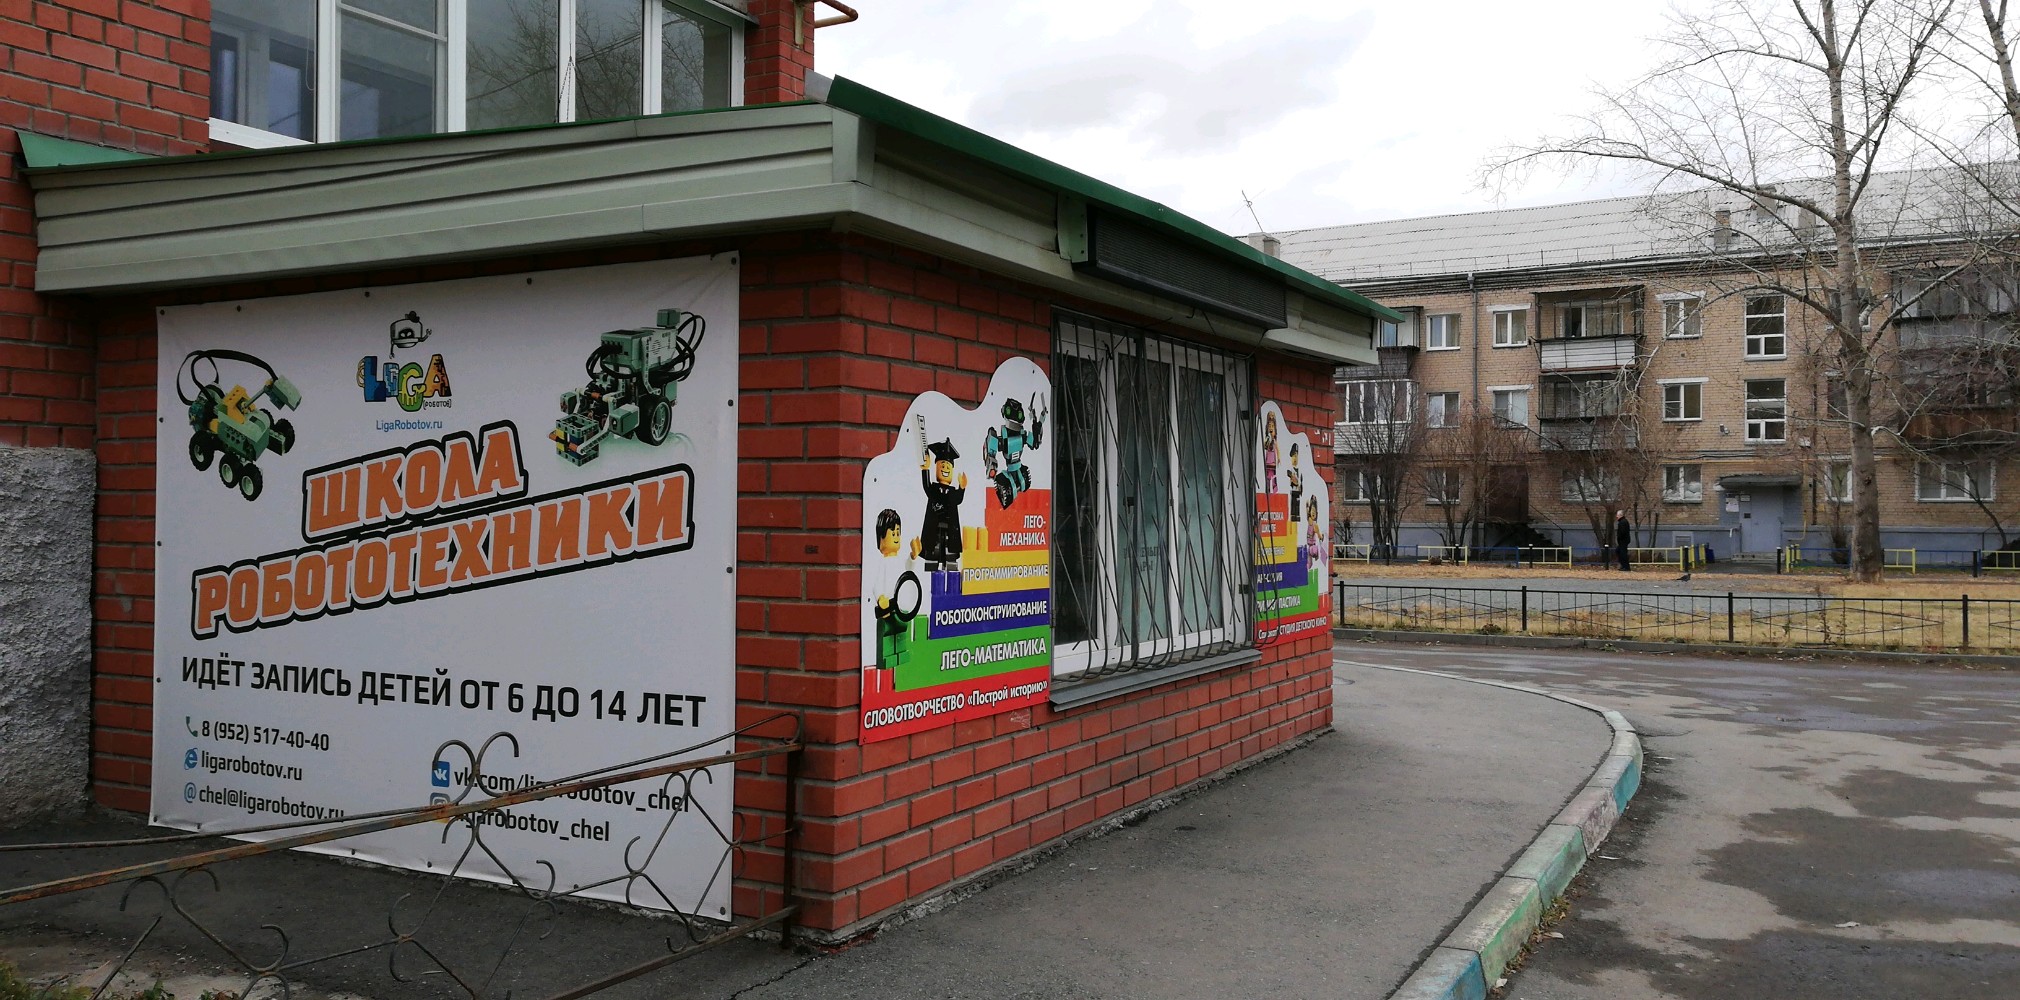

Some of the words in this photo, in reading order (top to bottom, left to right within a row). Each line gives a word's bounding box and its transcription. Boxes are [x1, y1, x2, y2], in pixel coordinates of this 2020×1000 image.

[376, 420, 443, 433] LigaRobotov.ru
[305, 425, 523, 537] ШКОЛА
[1023, 515, 1046, 529] ЛЕГО-
[194, 471, 690, 634] РОБОТОТЕХНИКИ
[1000, 532, 1046, 547] МЕХАНИКА
[963, 564, 1049, 582] ПРОГРАММИРОВАНИЕ
[935, 600, 1047, 626] РОБОТОКОНСТРУИРОВАНИЕ
[1316, 616, 1327, 628] КИНО
[940, 637, 1047, 671] ЛЕГО-МАТЕМАТИКА
[182, 652, 245, 690] ИДЁТ
[250, 662, 351, 696] ЗАПИСЬ
[358, 668, 451, 706] ДЕТЕЙ
[460, 679, 500, 710] ОТ
[508, 683, 524, 713] 6
[532, 685, 579, 722] ДО
[590, 689, 626, 721] 14
[637, 692, 706, 727] ЛЕТ
[864, 693, 965, 729] СЛОВОТВОРЧЕСТВО
[967, 686, 1008, 707] «Построй
[1010, 680, 1047, 699] историю»
[202, 720, 210, 737] 8
[214, 721, 249, 744] (952)
[253, 726, 330, 751] 517-40-40
[201, 751, 303, 781] ligarobotov.ru
